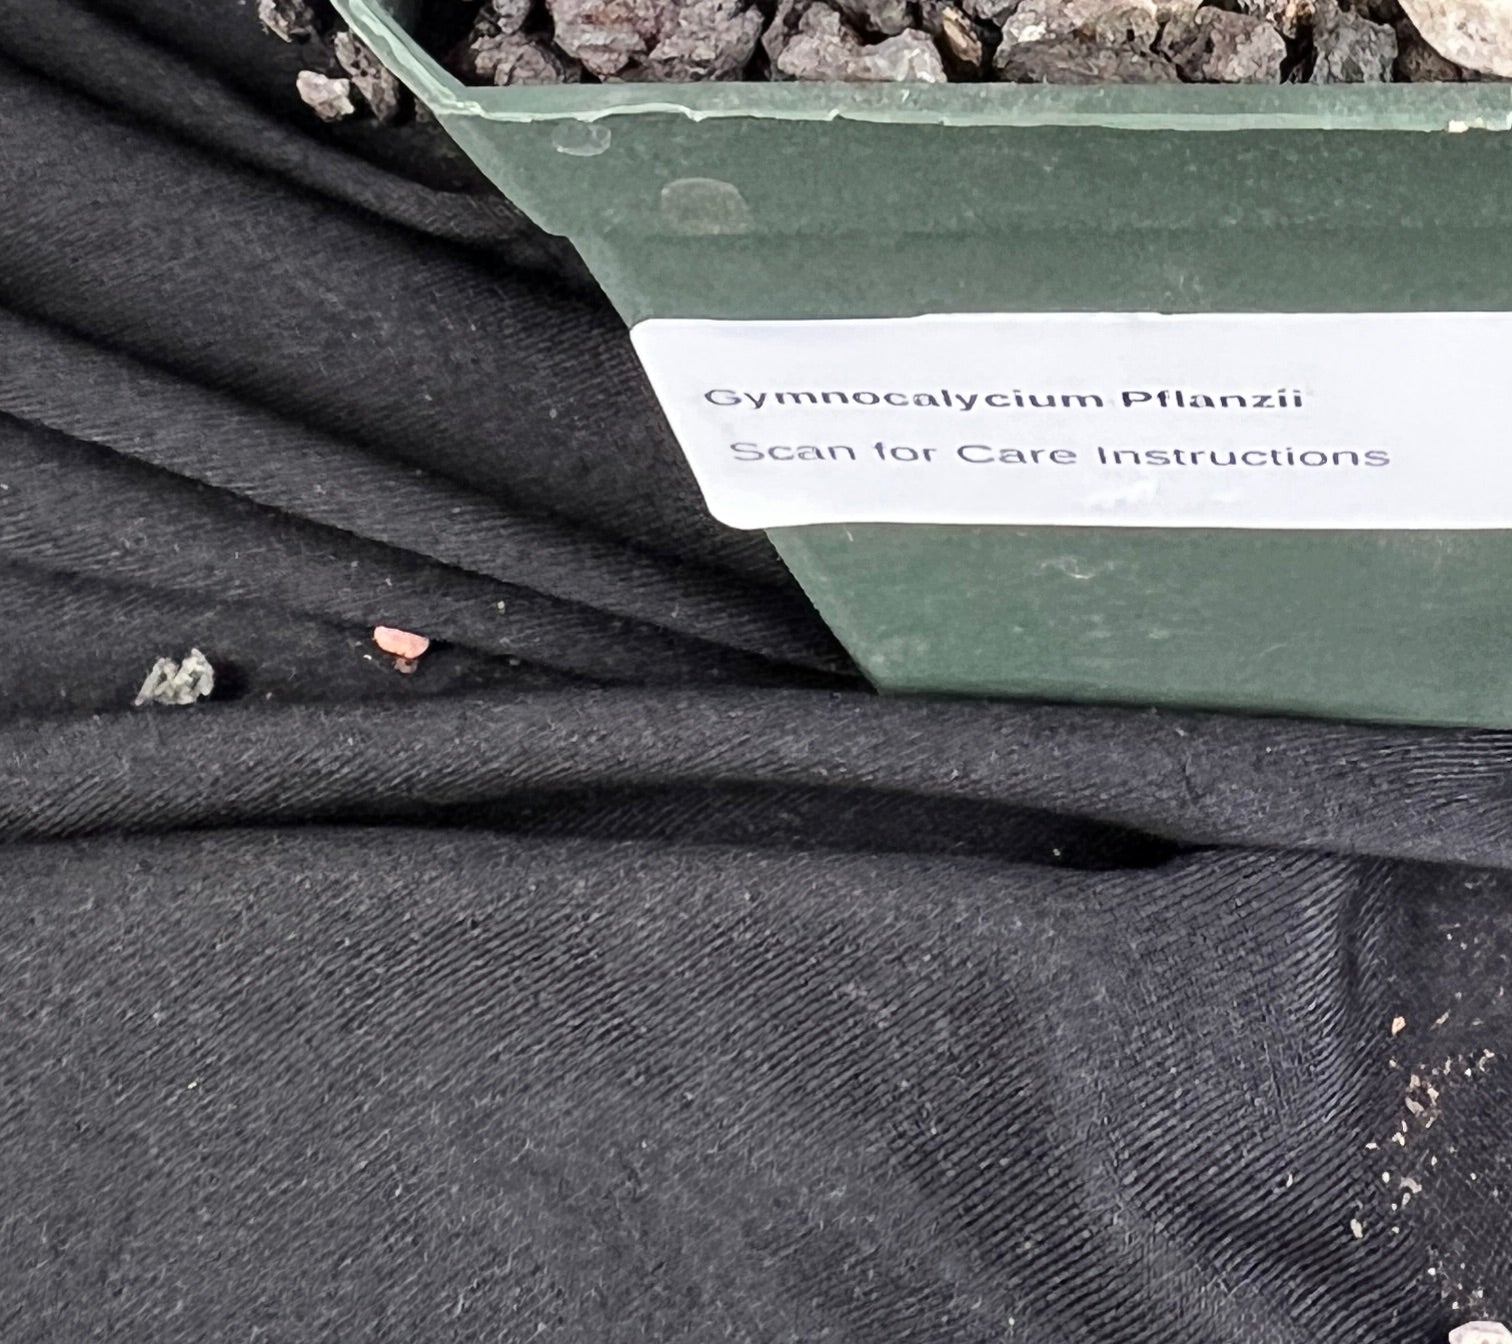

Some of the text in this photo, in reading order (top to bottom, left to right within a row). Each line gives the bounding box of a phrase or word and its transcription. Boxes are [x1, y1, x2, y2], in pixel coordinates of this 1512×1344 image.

[704, 388, 1304, 412] Gymnocalycium Pflanzii
[729, 441, 1391, 467] Scan for Care Instructions
